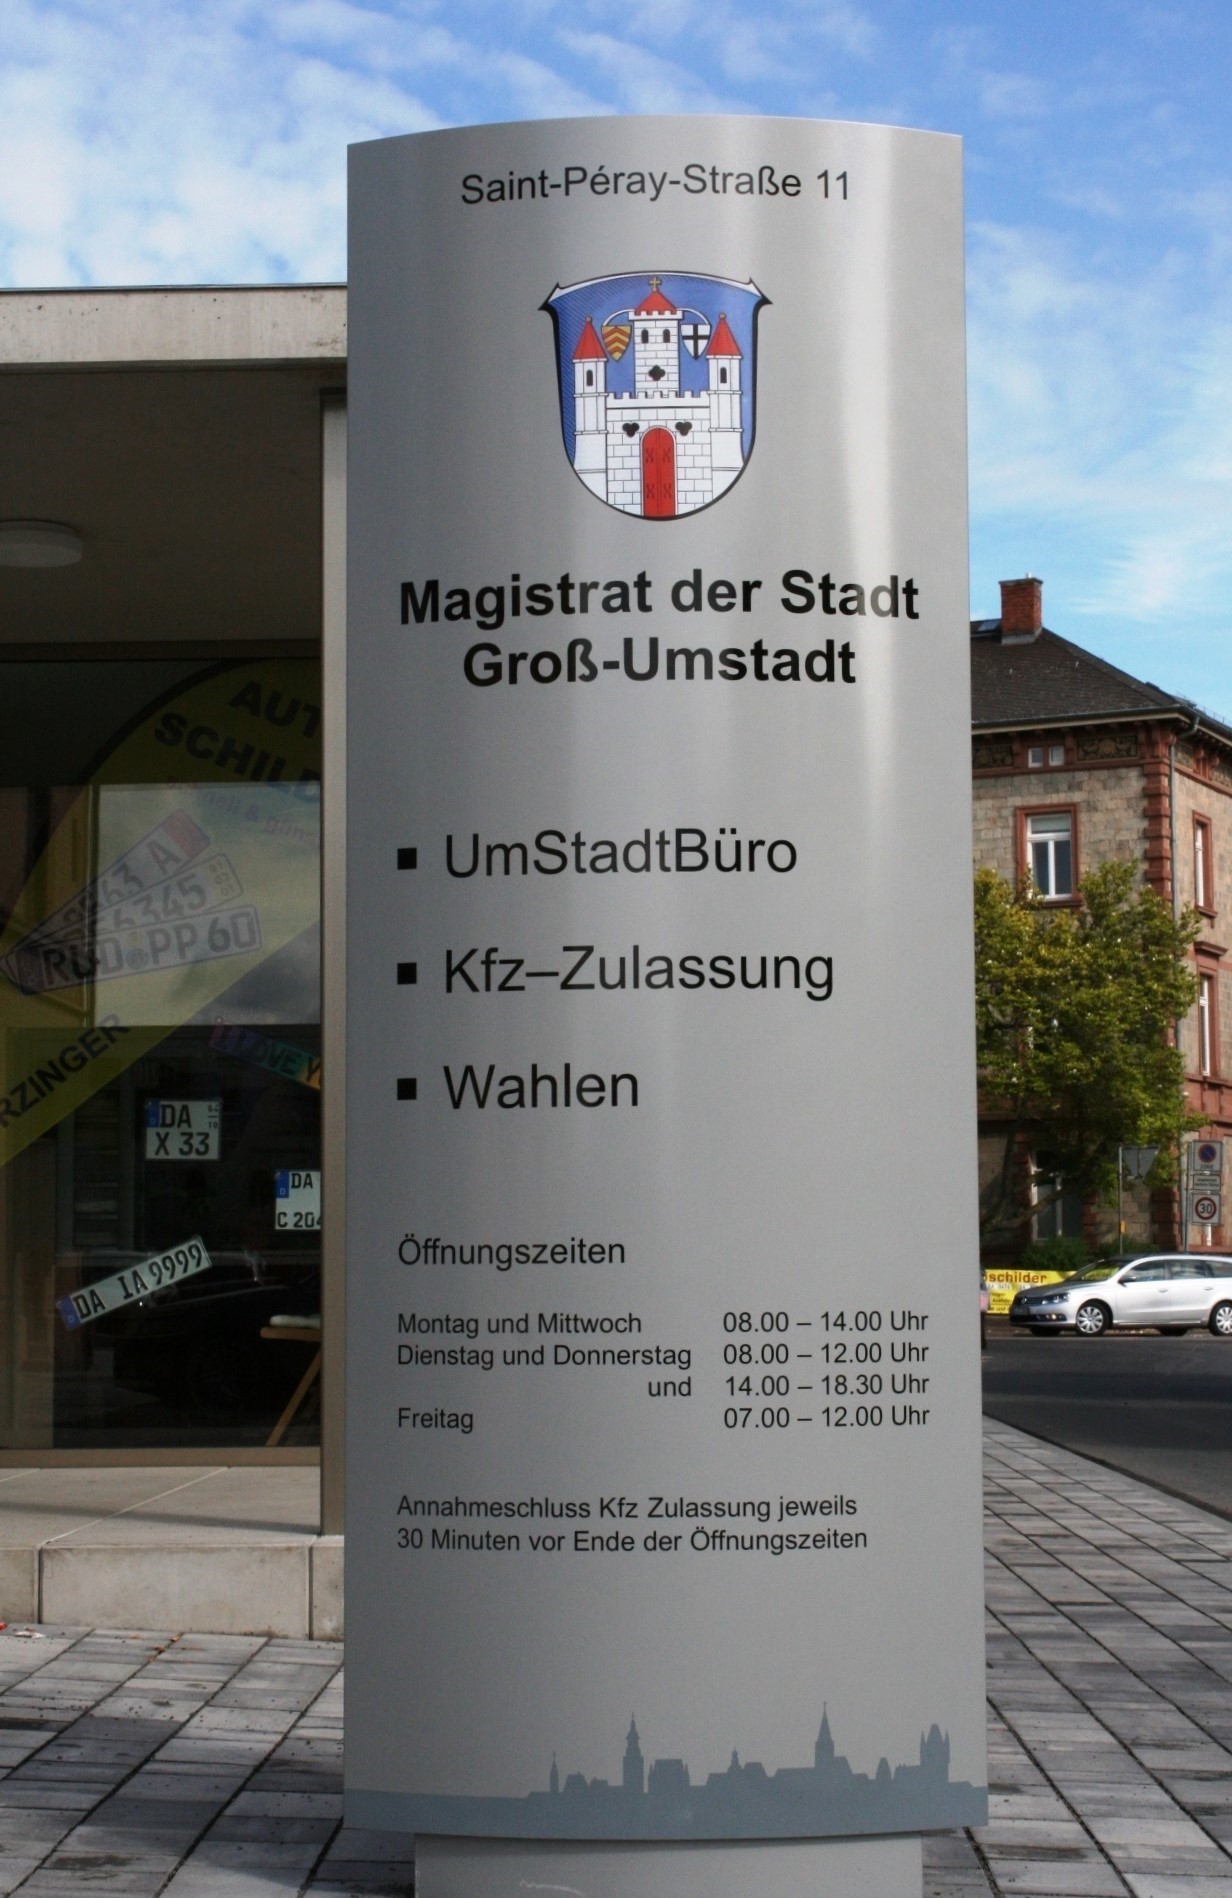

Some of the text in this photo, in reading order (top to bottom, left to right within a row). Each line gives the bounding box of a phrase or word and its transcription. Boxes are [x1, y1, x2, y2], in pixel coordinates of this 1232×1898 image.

[461, 163, 849, 205] Saint-Péray-Straße 11
[400, 568, 920, 631] Magistrat der Stadt
[463, 636, 857, 688] Groß-Umstadt
[445, 827, 798, 879] UmStadtBüro
[442, 1062, 639, 1110] Wahlen
[160, 1103, 192, 1129] DA
[154, 1131, 210, 1156] X 33
[291, 1172, 314, 1189] DA
[277, 1211, 288, 1228] C
[1199, 1203, 1213, 1214] 30
[398, 1234, 626, 1272] Öffnungszeiten
[73, 1289, 106, 1320] DA
[148, 1243, 202, 1286] 9999
[398, 1312, 642, 1338] Montag und Mittwoch
[722, 1311, 790, 1333] 08.00
[820, 1310, 883, 1332] 14.00
[890, 1309, 929, 1332] Uhr
[397, 1344, 692, 1370] Dienstag und Donnerstag
[723, 1342, 790, 1365] 08.00
[821, 1341, 882, 1364] 12.00
[890, 1341, 930, 1363] Uhr
[647, 1375, 692, 1398] und
[725, 1374, 790, 1397] 14.00
[821, 1373, 883, 1396] 18.30
[891, 1373, 930, 1395] Uhr
[398, 1407, 474, 1435] Freitag
[723, 1406, 790, 1429] 07.00
[821, 1405, 883, 1428] 12.00
[891, 1404, 931, 1427] Uhr
[397, 1494, 858, 1523] Annahmeschluss Kfz Zulassung jeweils
[397, 1525, 868, 1556] 30 Minuten vor Ende der Öffnungszeiten
